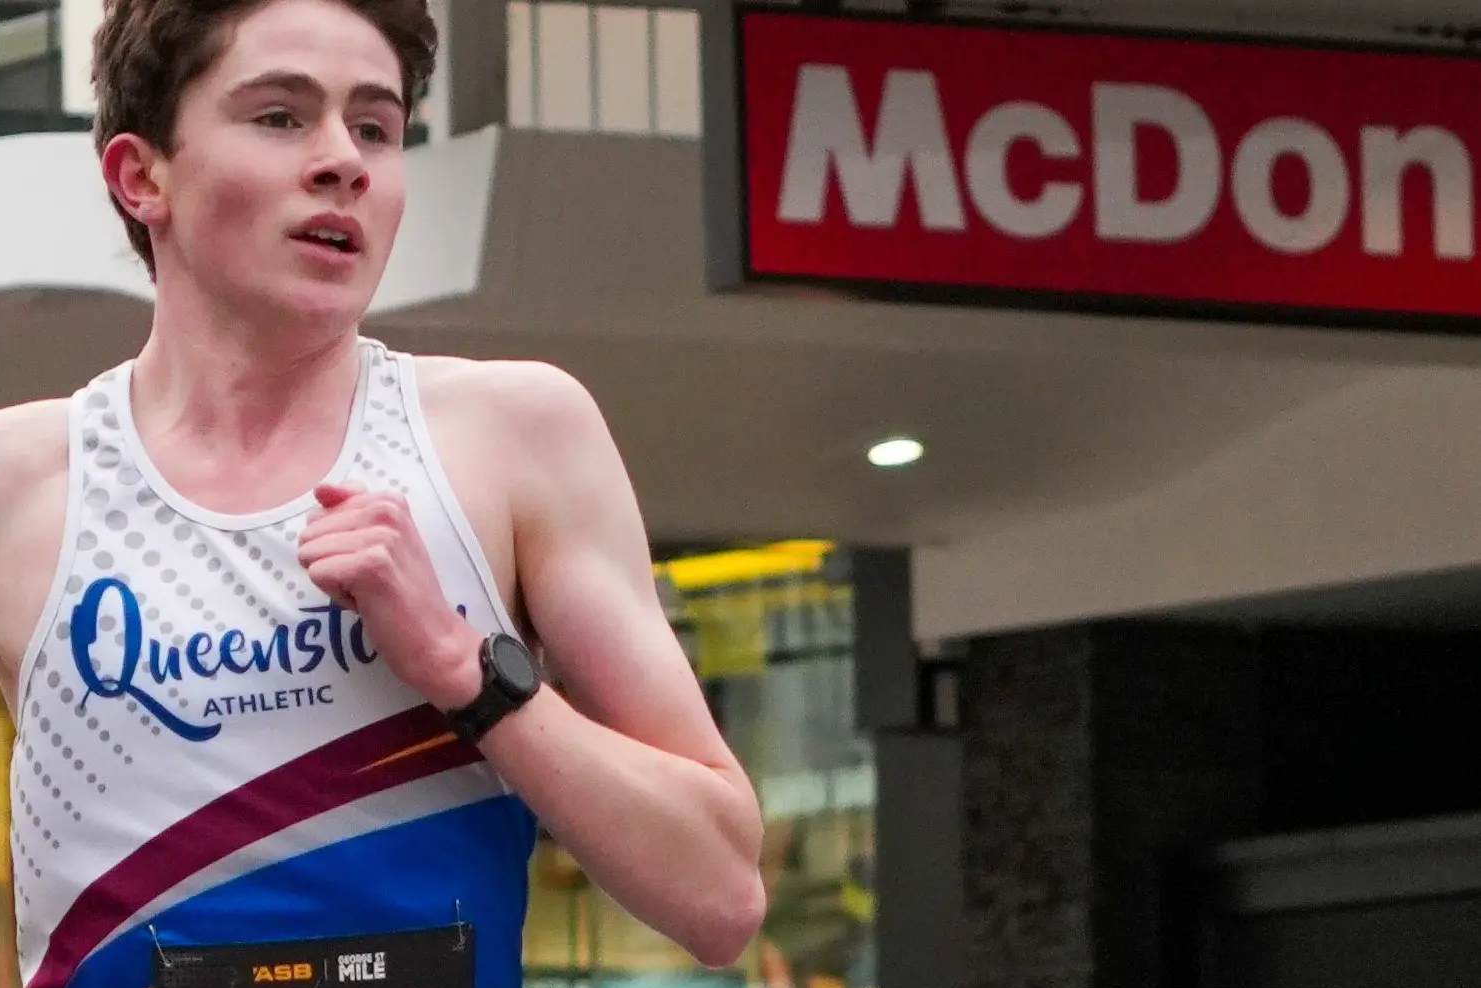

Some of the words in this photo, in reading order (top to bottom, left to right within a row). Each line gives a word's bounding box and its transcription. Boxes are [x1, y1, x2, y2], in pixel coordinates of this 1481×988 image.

[776, 62, 1475, 261] McDon
[70, 577, 467, 741] Queensto
[203, 685, 334, 718] ATHLETIC
[252, 963, 313, 982] ASB
[337, 962, 387, 982] MILE
